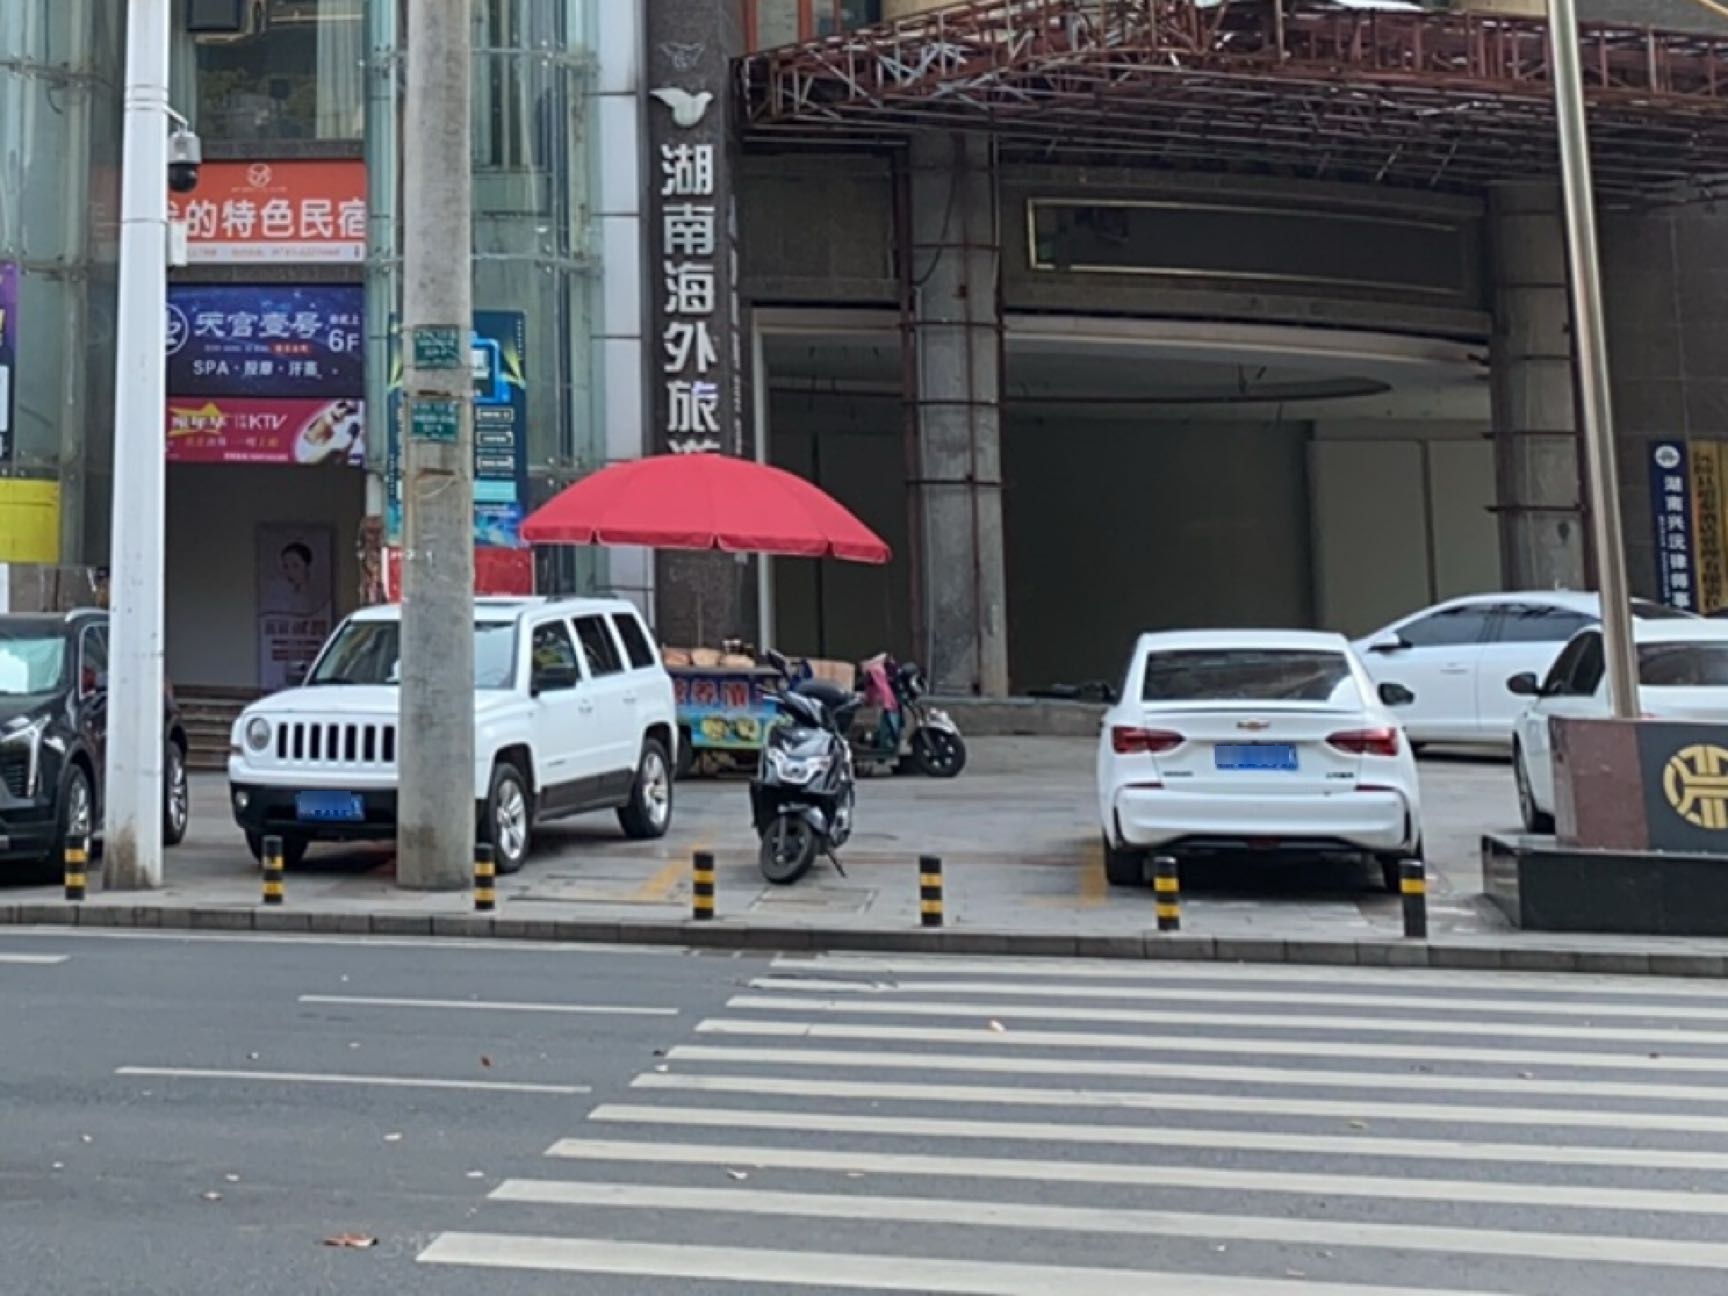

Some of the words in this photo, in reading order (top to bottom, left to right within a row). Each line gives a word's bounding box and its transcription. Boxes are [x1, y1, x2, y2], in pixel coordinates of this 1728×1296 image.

[167, 198, 366, 239] 的特色民宿
[660, 143, 720, 454] 湖南海外旅
[194, 311, 322, 339] 天宫壹号
[328, 329, 360, 352] 6F
